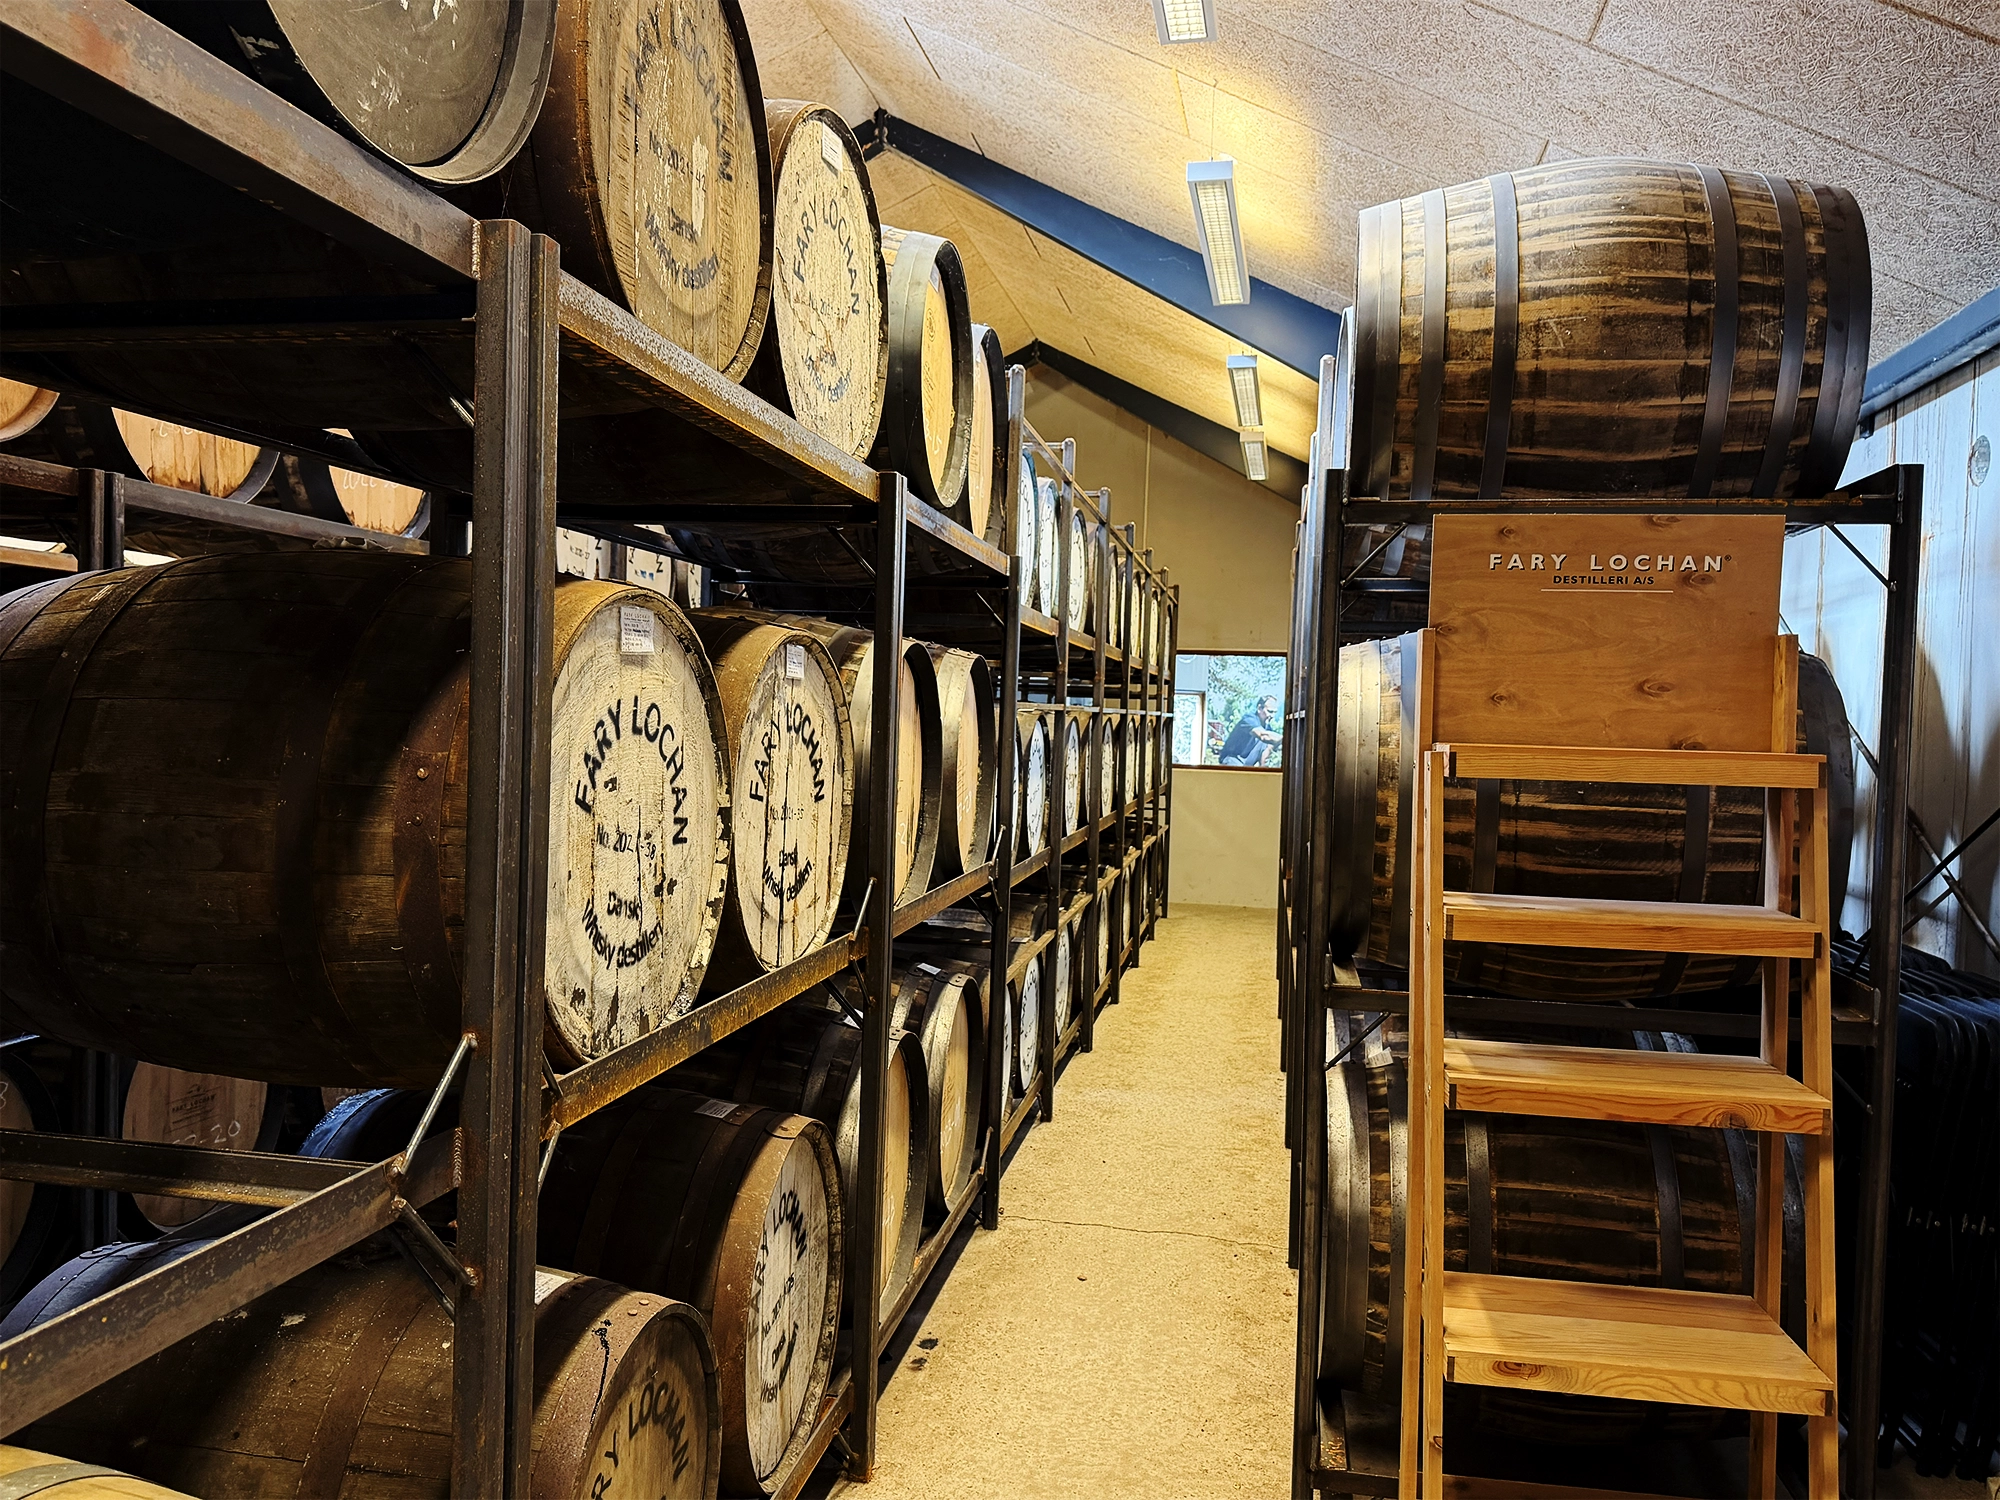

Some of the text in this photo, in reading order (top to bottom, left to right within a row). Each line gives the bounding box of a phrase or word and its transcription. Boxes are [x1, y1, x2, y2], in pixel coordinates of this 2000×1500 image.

[793, 191, 861, 316] FARY LOCHAN
[1489, 553, 1567, 571] FARY
[1553, 575, 1655, 585] DESTILLERI A/S
[575, 695, 688, 845] FARY LOCHAN
[750, 702, 826, 804] FARY LOCHAN
[612, 829, 657, 861] 202-38
[582, 898, 663, 971] Whisky destilleri
[607, 890, 642, 922] Dansk
[773, 1189, 808, 1262] LOCHAN
[590, 1381, 690, 1500] RY LOCHAN
